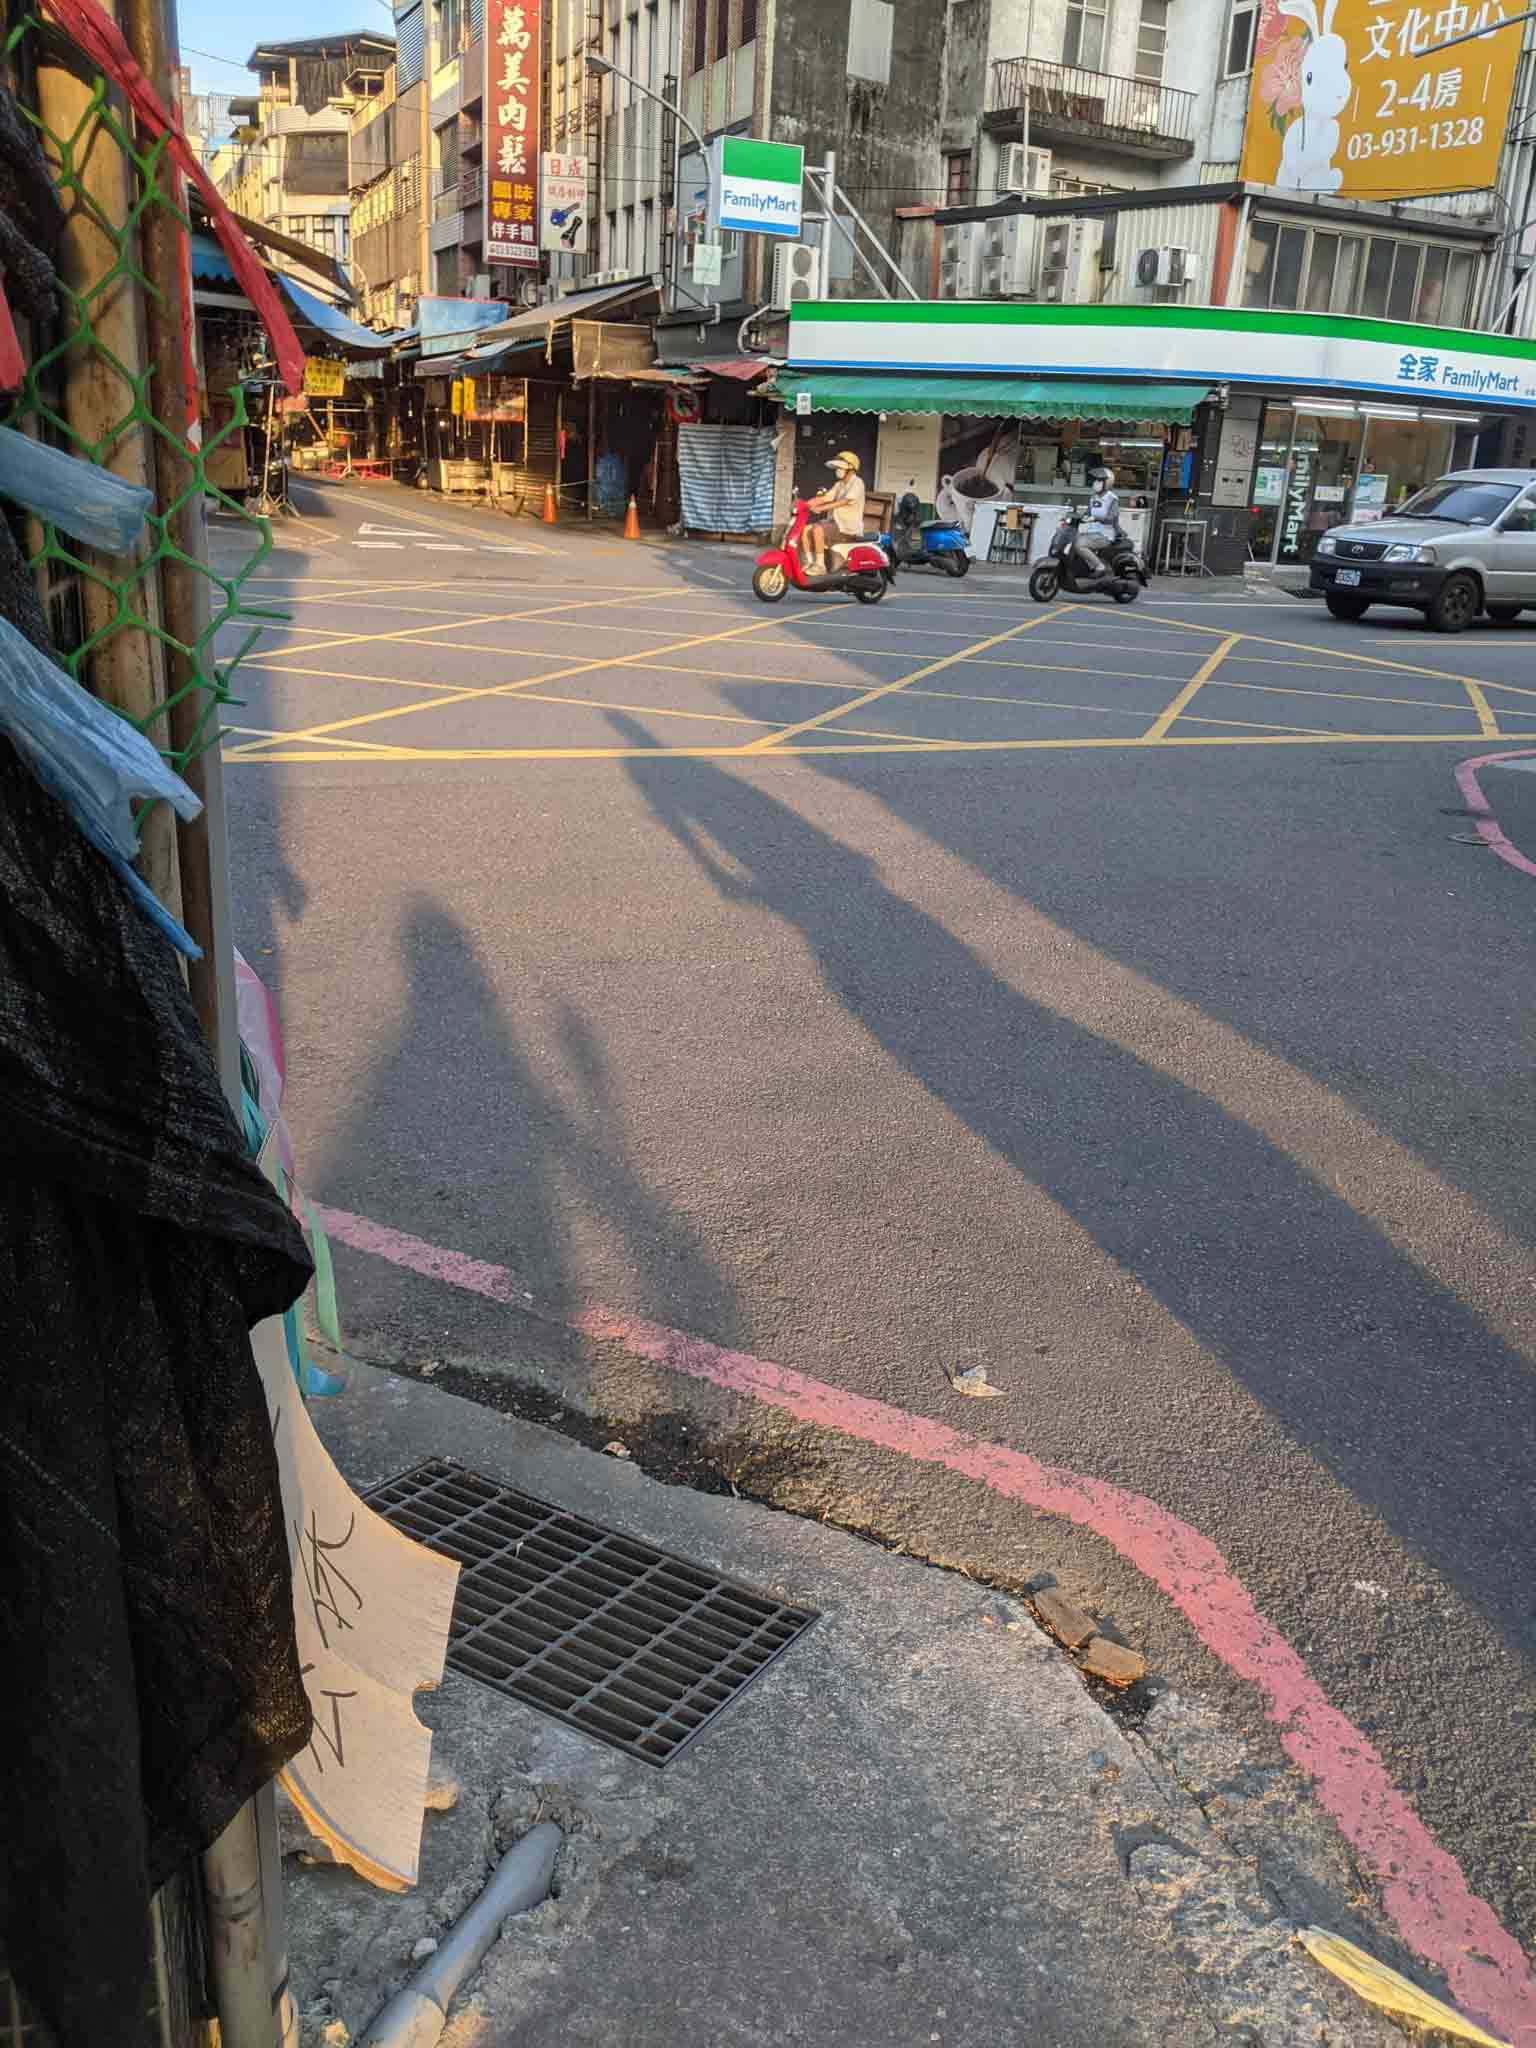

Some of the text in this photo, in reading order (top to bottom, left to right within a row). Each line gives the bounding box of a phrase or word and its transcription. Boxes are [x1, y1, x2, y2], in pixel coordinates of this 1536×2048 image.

[1360, 0, 1506, 64] 文化中心
[496, 4, 531, 176] 萬美肉鬆
[1375, 67, 1463, 118] 2-4房
[1347, 116, 1485, 160] 03-931-1328
[723, 190, 798, 214] FamilyMart
[1397, 353, 1439, 382] 全家
[1442, 366, 1520, 393] FamilyMart
